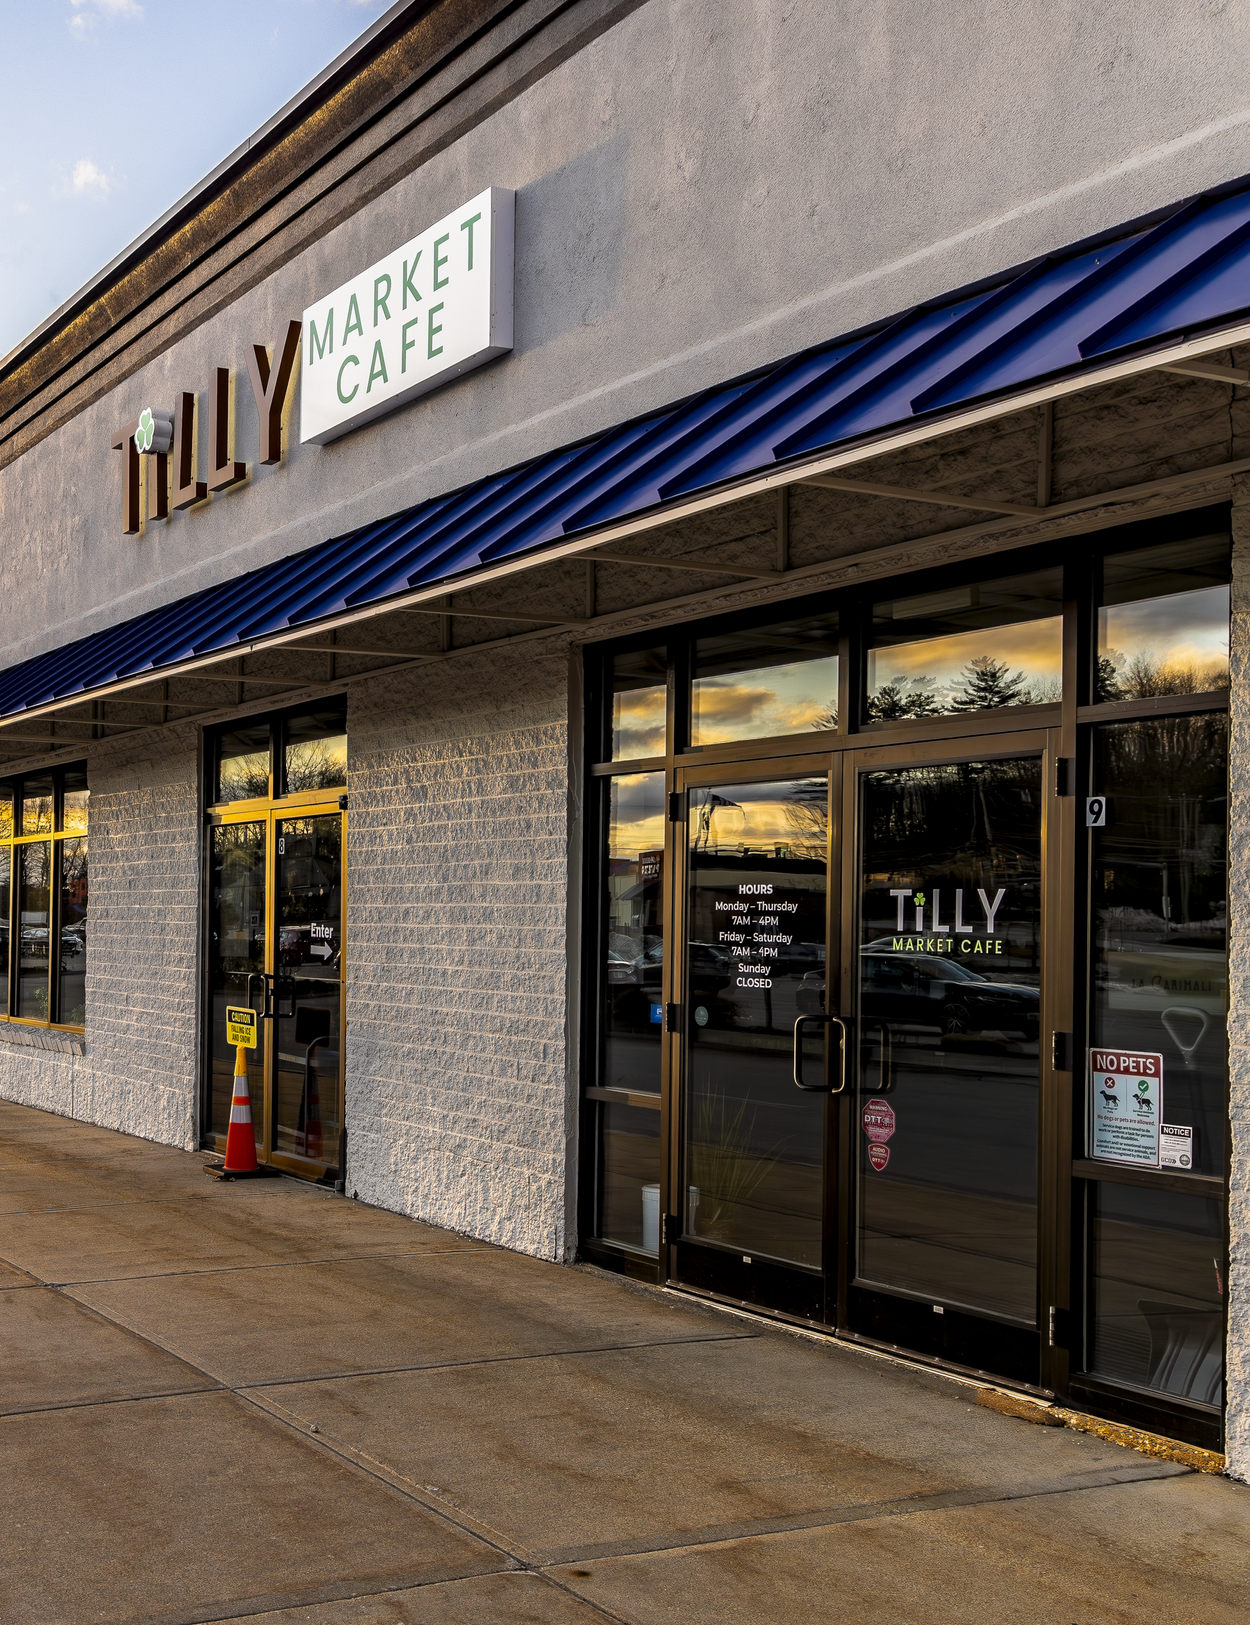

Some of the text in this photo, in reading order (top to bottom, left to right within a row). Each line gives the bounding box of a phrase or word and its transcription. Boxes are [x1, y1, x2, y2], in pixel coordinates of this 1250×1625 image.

[309, 212, 481, 366] MARKET
[336, 301, 444, 405] CAFE
[1089, 799, 1104, 824] 9
[738, 884, 774, 894] HOURS
[715, 901, 749, 913] Monday
[756, 901, 798, 913] Thursday
[732, 916, 750, 925] 7AM
[759, 916, 779, 926] 4PM
[311, 922, 334, 938] Enter
[719, 931, 745, 943] Friday
[753, 932, 792, 945] Saturday
[732, 946, 750, 956] 7AM
[758, 947, 778, 957] 4PM
[892, 938, 1002, 954] MARKET CAFE
[738, 963, 771, 976] Sunday
[736, 977, 772, 988] CLOSED
[232, 1012, 250, 1024] CAUTION
[1096, 1054, 1155, 1074] NO PETS
[864, 1115, 882, 1124] DTT
[1163, 1126, 1190, 1136] NOTICE
